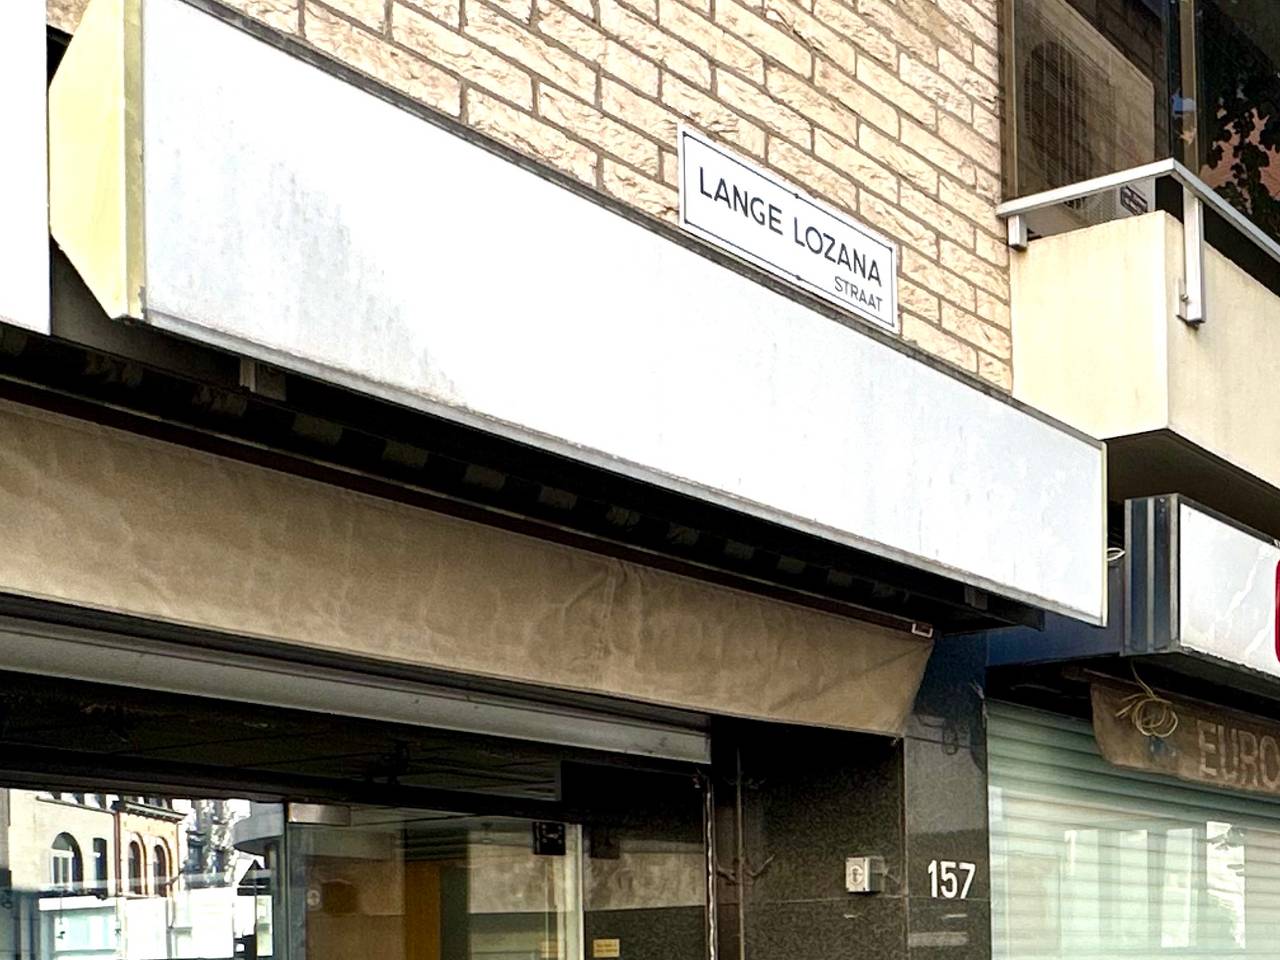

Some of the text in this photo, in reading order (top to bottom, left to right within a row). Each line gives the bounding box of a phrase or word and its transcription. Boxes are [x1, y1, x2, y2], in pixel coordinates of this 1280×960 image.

[699, 166, 883, 288] LANGE LOZANA
[834, 275, 884, 312] STRAAT
[928, 859, 976, 900] 157
